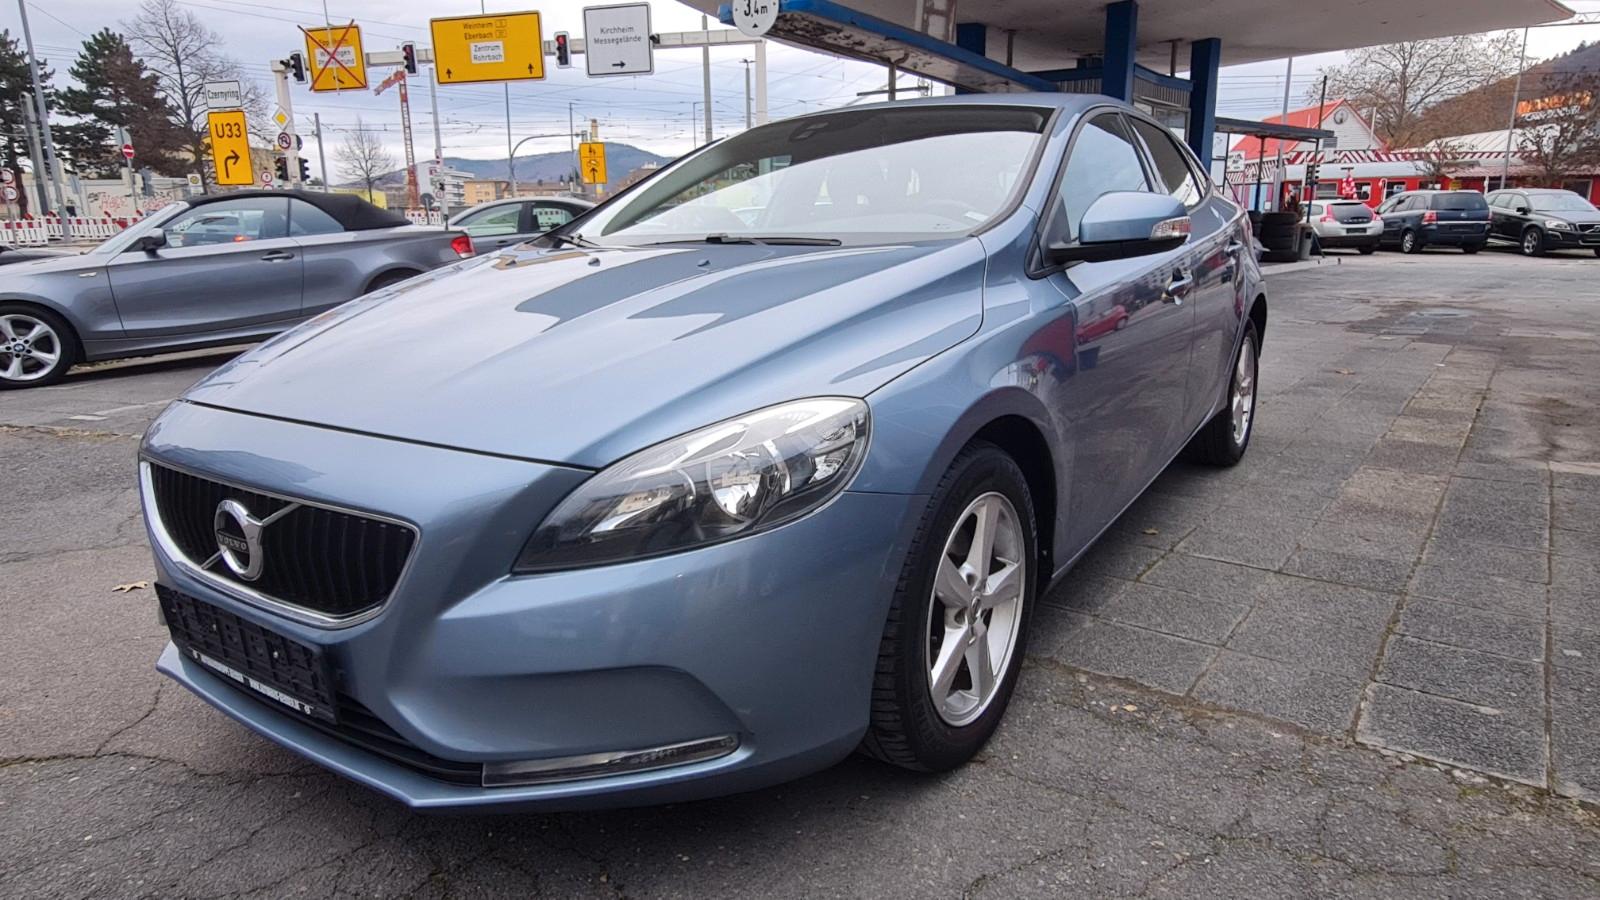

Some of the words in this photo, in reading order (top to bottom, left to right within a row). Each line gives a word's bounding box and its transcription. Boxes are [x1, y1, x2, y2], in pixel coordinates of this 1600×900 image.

[600, 26, 634, 34] Kirchheim
[593, 36, 641, 45] Messegelände
[473, 44, 501, 52] Zentrum
[215, 122, 242, 138] U33
[218, 533, 247, 550] VOLVO
